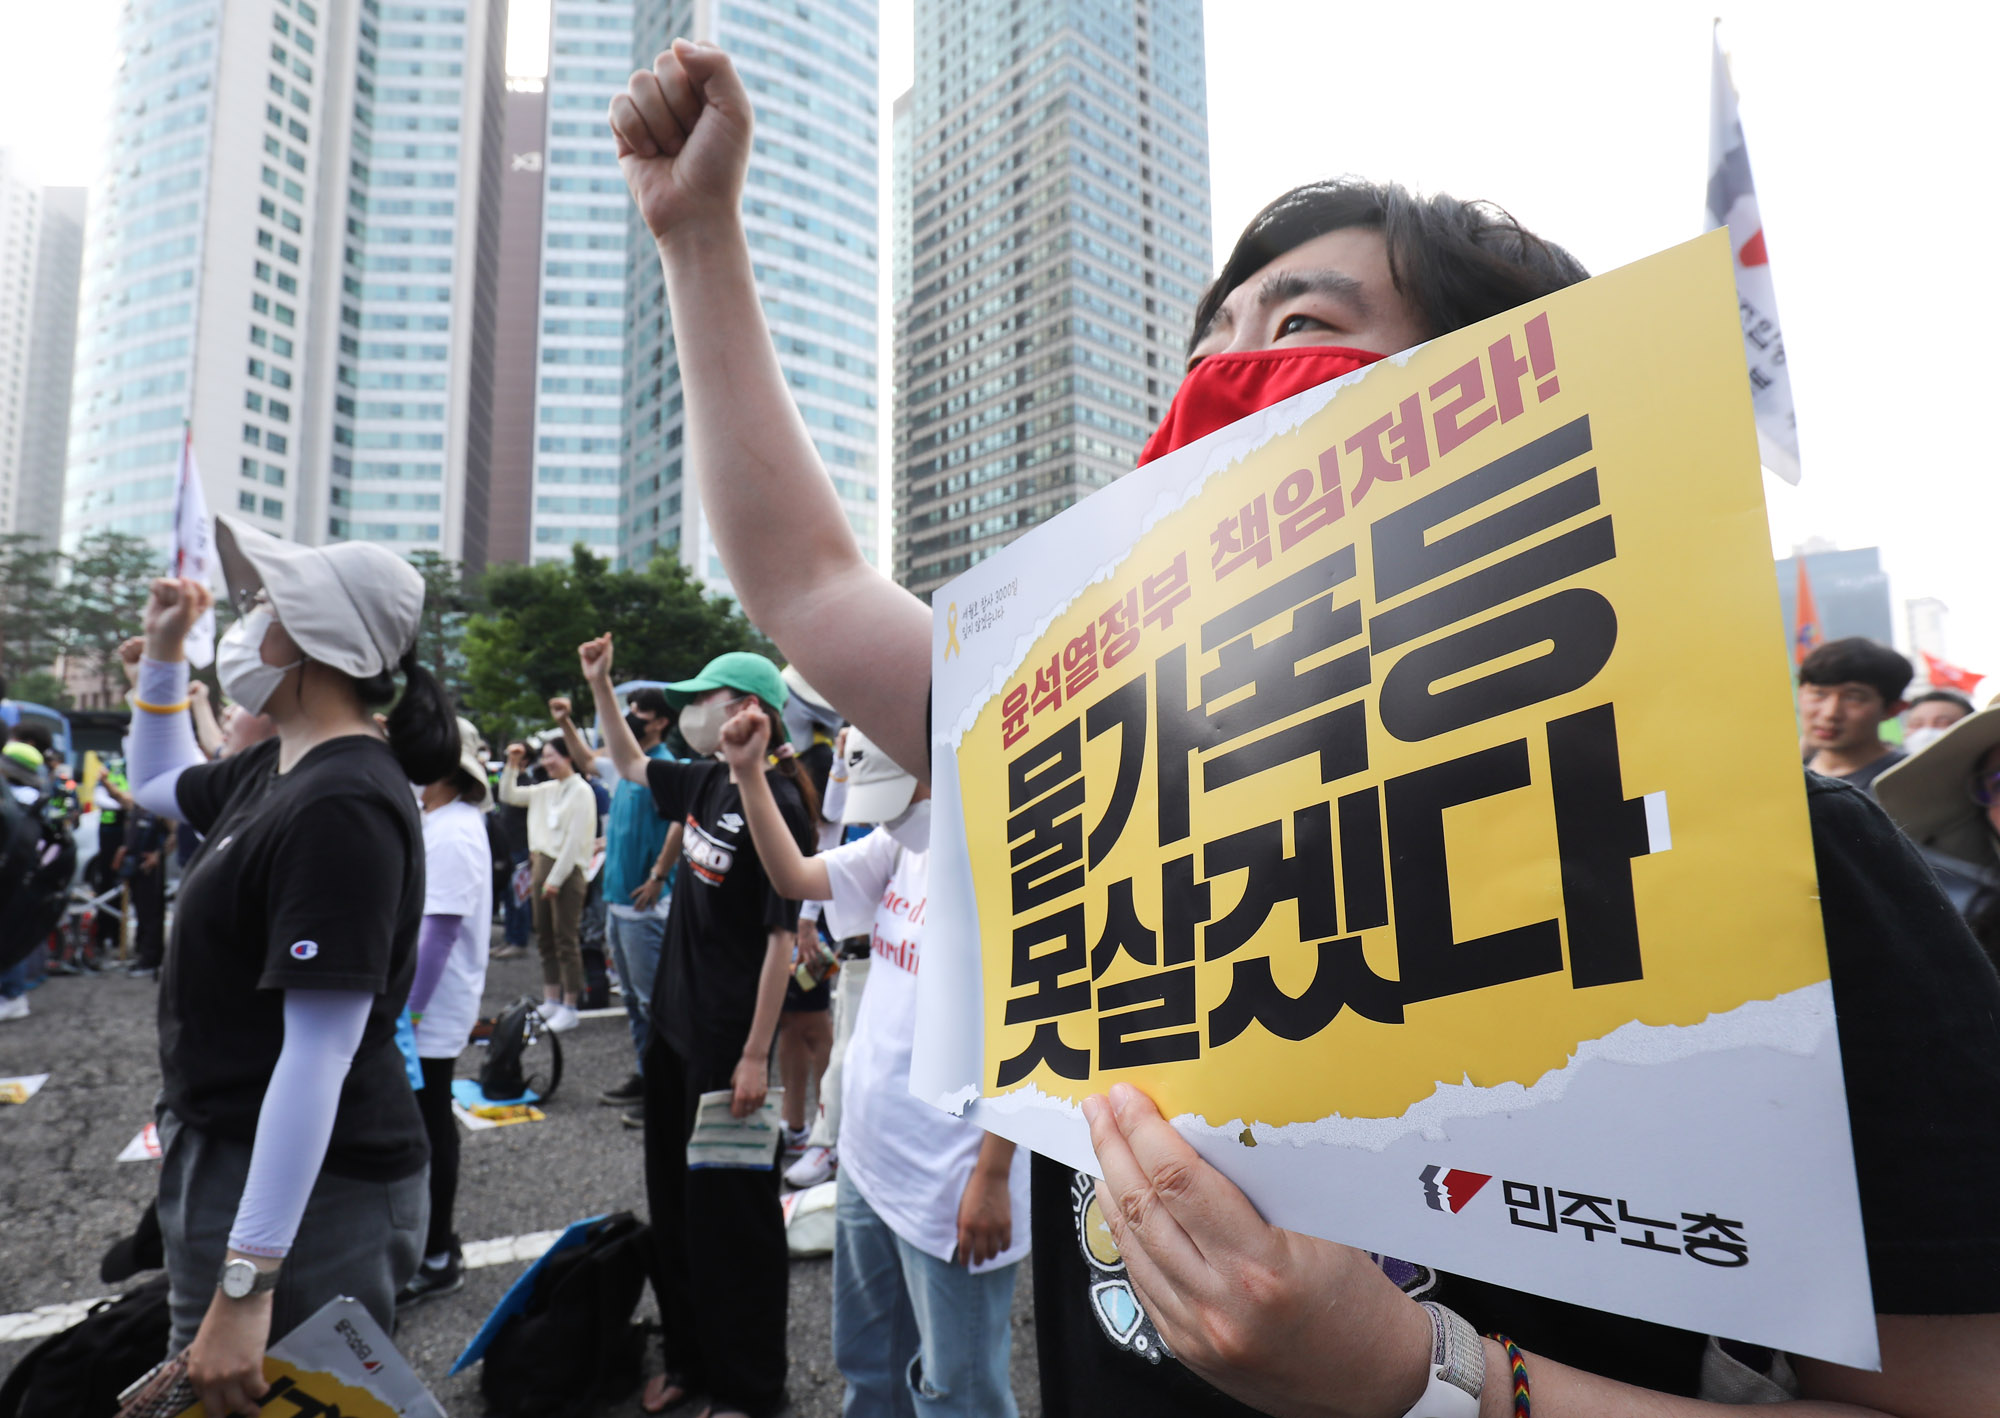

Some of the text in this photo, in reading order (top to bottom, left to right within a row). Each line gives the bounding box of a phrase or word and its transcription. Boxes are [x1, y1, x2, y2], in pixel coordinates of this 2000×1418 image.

[981, 593, 994, 613] 참사
[995, 577, 1018, 604] 3000일
[1001, 311, 1561, 751] 윤석열정부 책임져라!
[1007, 413, 1618, 916] 물가폭등
[996, 701, 1651, 1088] 못살겠다
[1502, 1180, 1749, 1268] 민주노총
